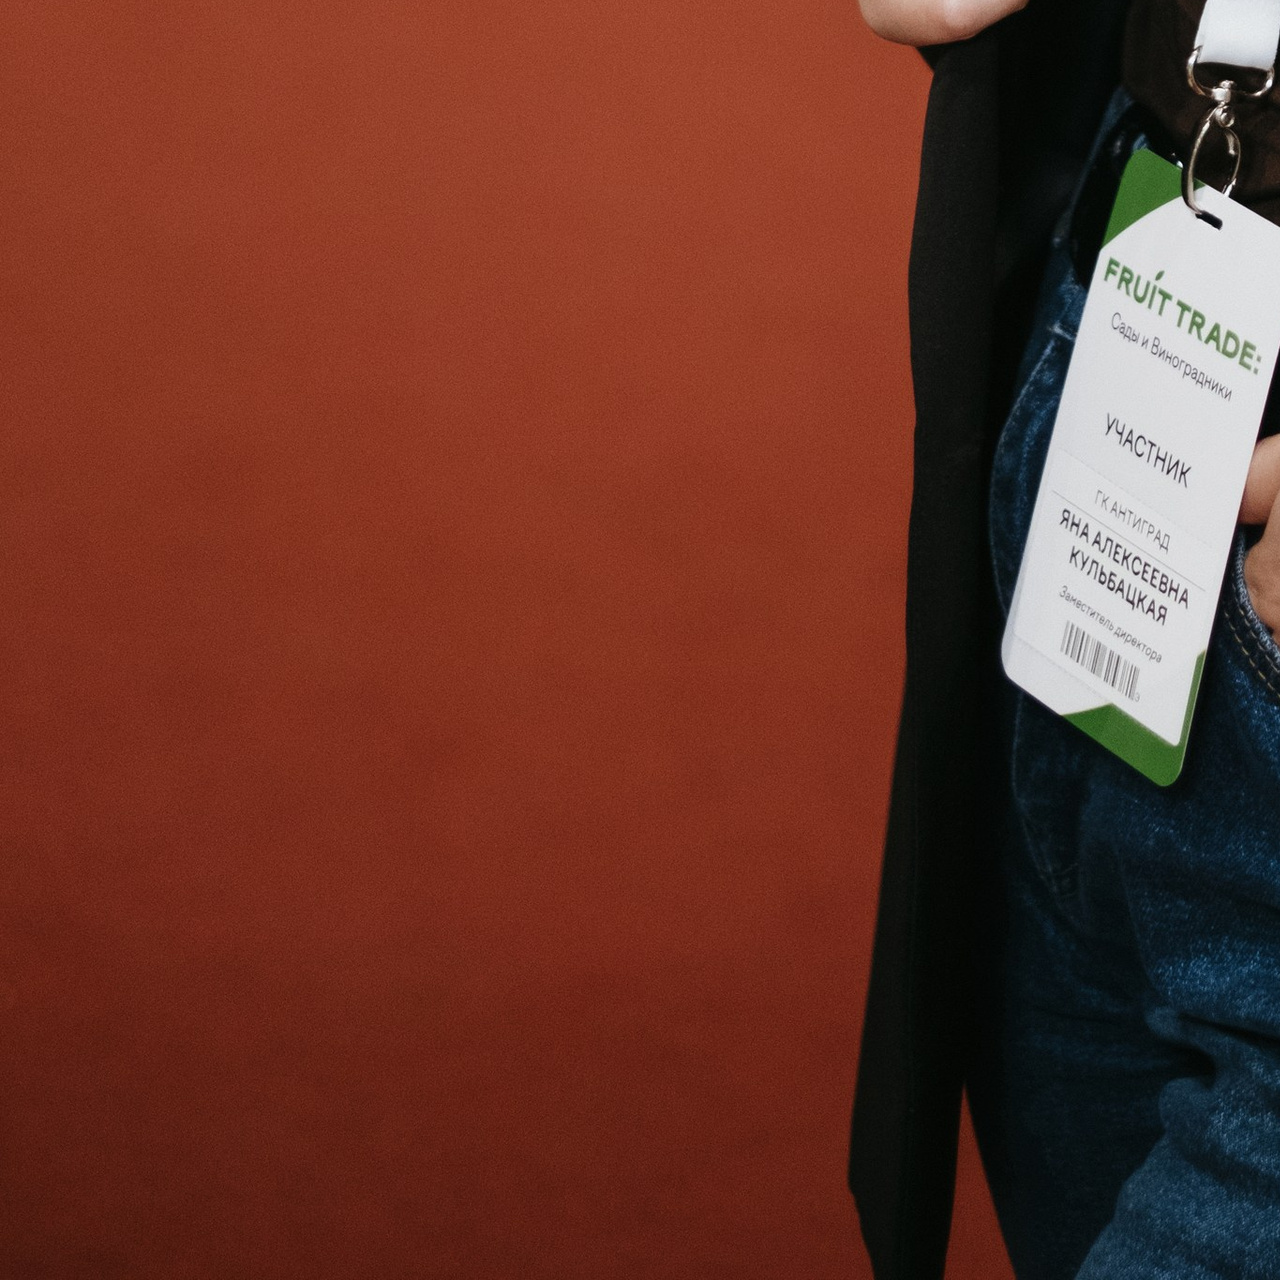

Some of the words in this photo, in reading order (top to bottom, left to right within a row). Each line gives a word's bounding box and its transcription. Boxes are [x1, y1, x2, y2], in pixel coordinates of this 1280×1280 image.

[1111, 312, 1140, 344] Сады
[1141, 336, 1150, 351] и
[1150, 336, 1233, 402] Виноградники
[1176, 299, 1262, 375] TRADE:
[1105, 412, 1192, 488] УЧАСТНИК
[1059, 508, 1090, 544] ЯНА
[1091, 530, 1190, 610] АЛЕКСЕЕВНА
[1094, 489, 1110, 511] ГК
[1110, 501, 1171, 555] АНТИГРАД
[1059, 585, 1115, 631] Заместитель
[1114, 626, 1163, 663] директора
[1069, 546, 1168, 626] КУЛЬБАЦКАЯ
